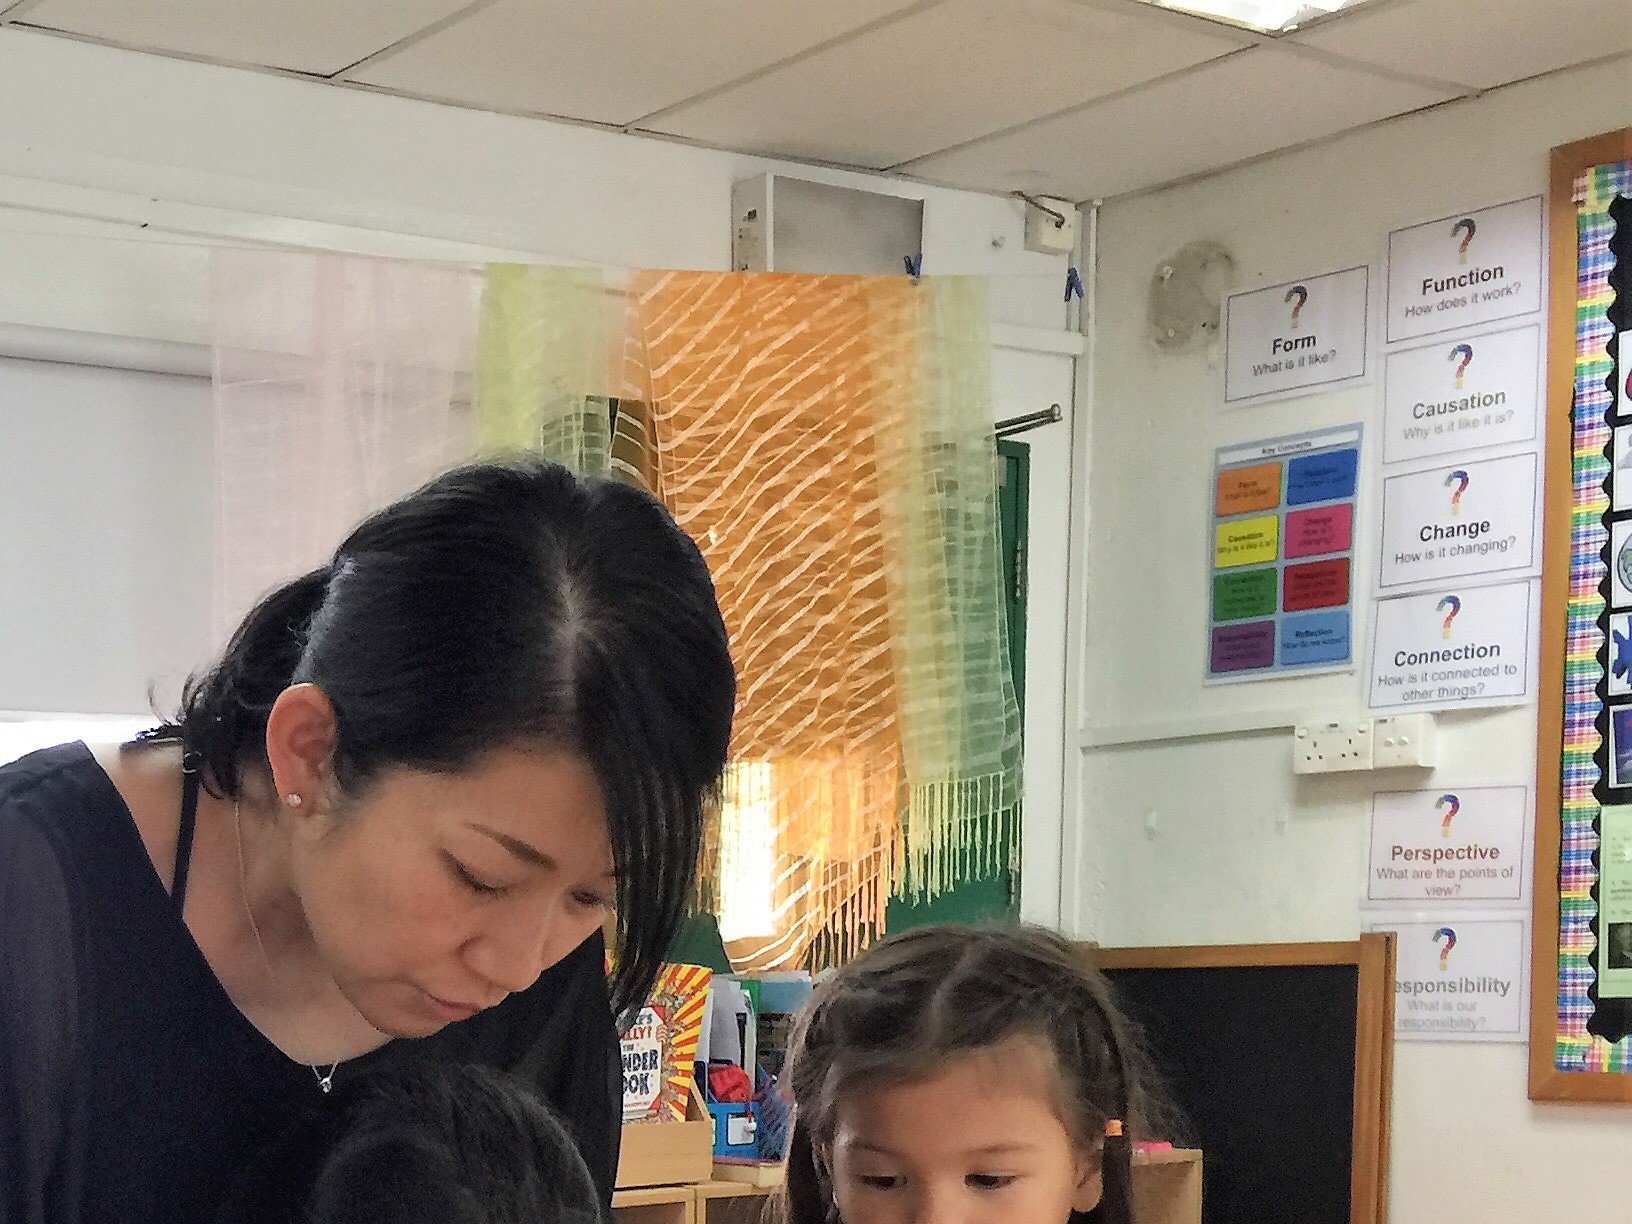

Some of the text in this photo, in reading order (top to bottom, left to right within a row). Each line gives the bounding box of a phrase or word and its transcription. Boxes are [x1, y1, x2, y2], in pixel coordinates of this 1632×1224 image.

[1421, 265, 1504, 296] Function
[1404, 281, 1522, 318] How does it work?
[1271, 335, 1317, 356] Form
[1252, 349, 1338, 377] What is it like?
[1412, 391, 1506, 420] Causation
[1403, 408, 1515, 440] Why is it like it is?
[1419, 520, 1491, 542] Change
[1394, 535, 1517, 565] How is it changing?
[1394, 642, 1501, 668] Connection
[1378, 663, 1518, 687] How is it connected to
[1402, 681, 1486, 702] other things?
[1391, 843, 1500, 865] Perspective
[1376, 865, 1514, 882] What are the points of
[1425, 883, 1461, 897] view?
[1394, 976, 1511, 998] esponsibility
[1407, 1000, 1479, 1012] What is our
[622, 1048, 659, 1072] NDER
